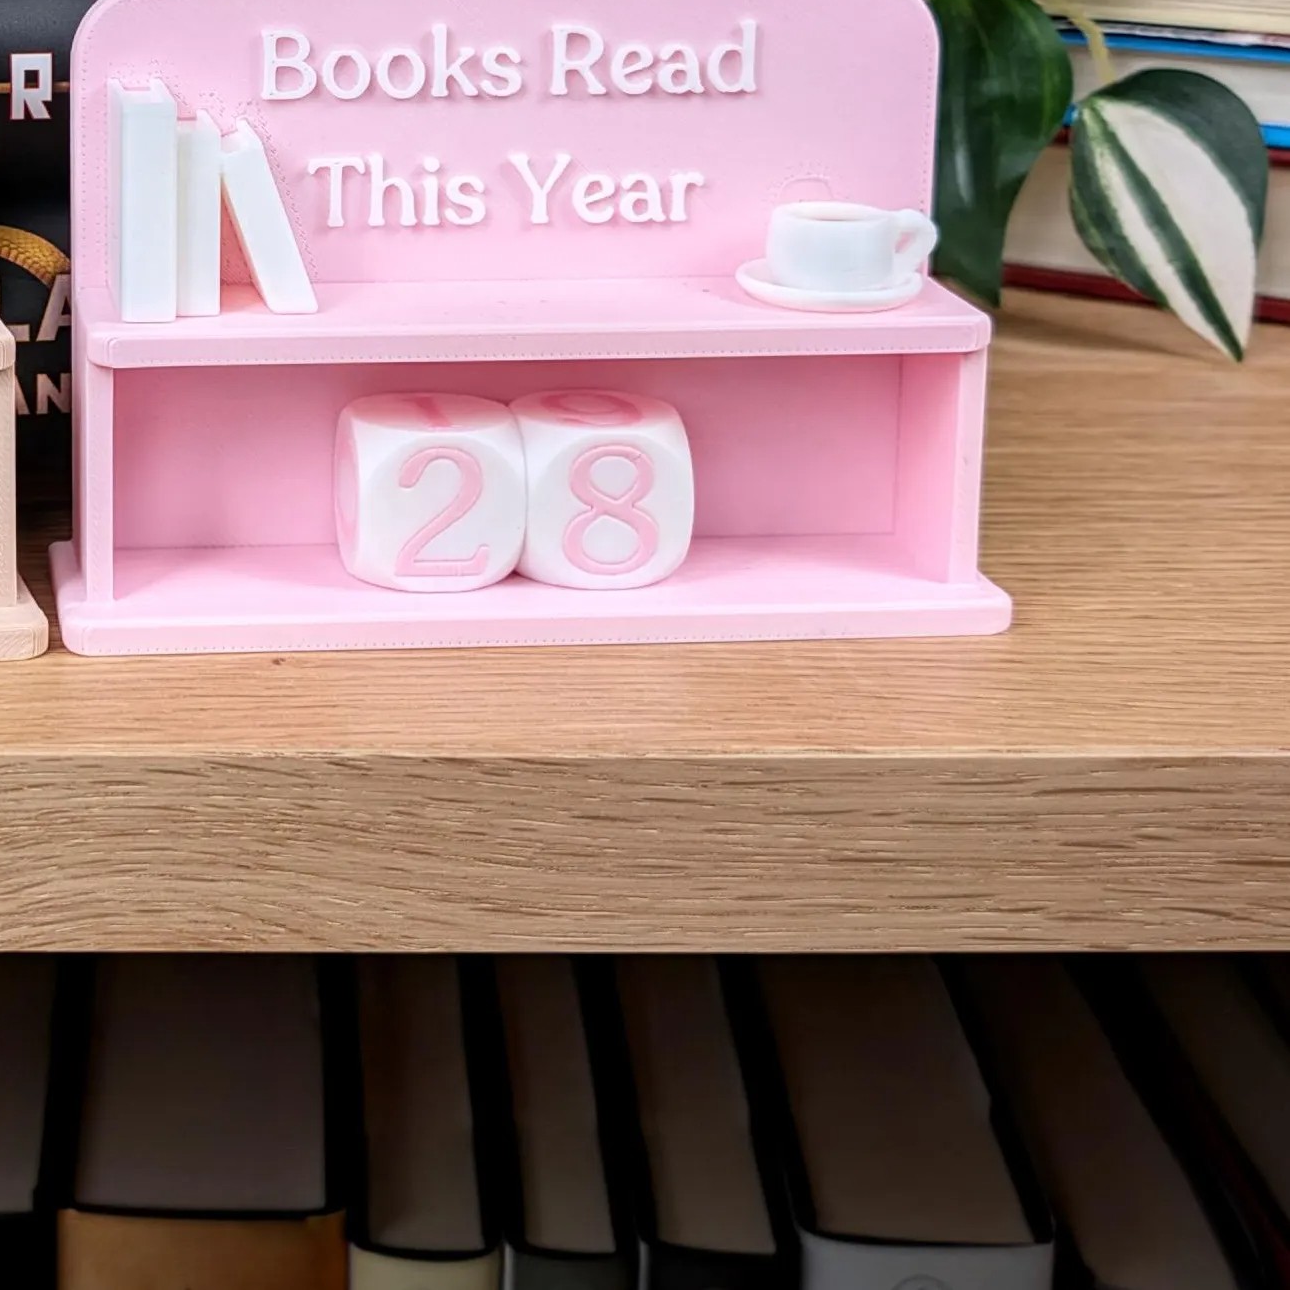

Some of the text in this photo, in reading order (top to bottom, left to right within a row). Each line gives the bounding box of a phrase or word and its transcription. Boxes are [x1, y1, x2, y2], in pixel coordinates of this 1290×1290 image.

[259, 19, 759, 103] Books Read
[307, 149, 707, 230] This Year
